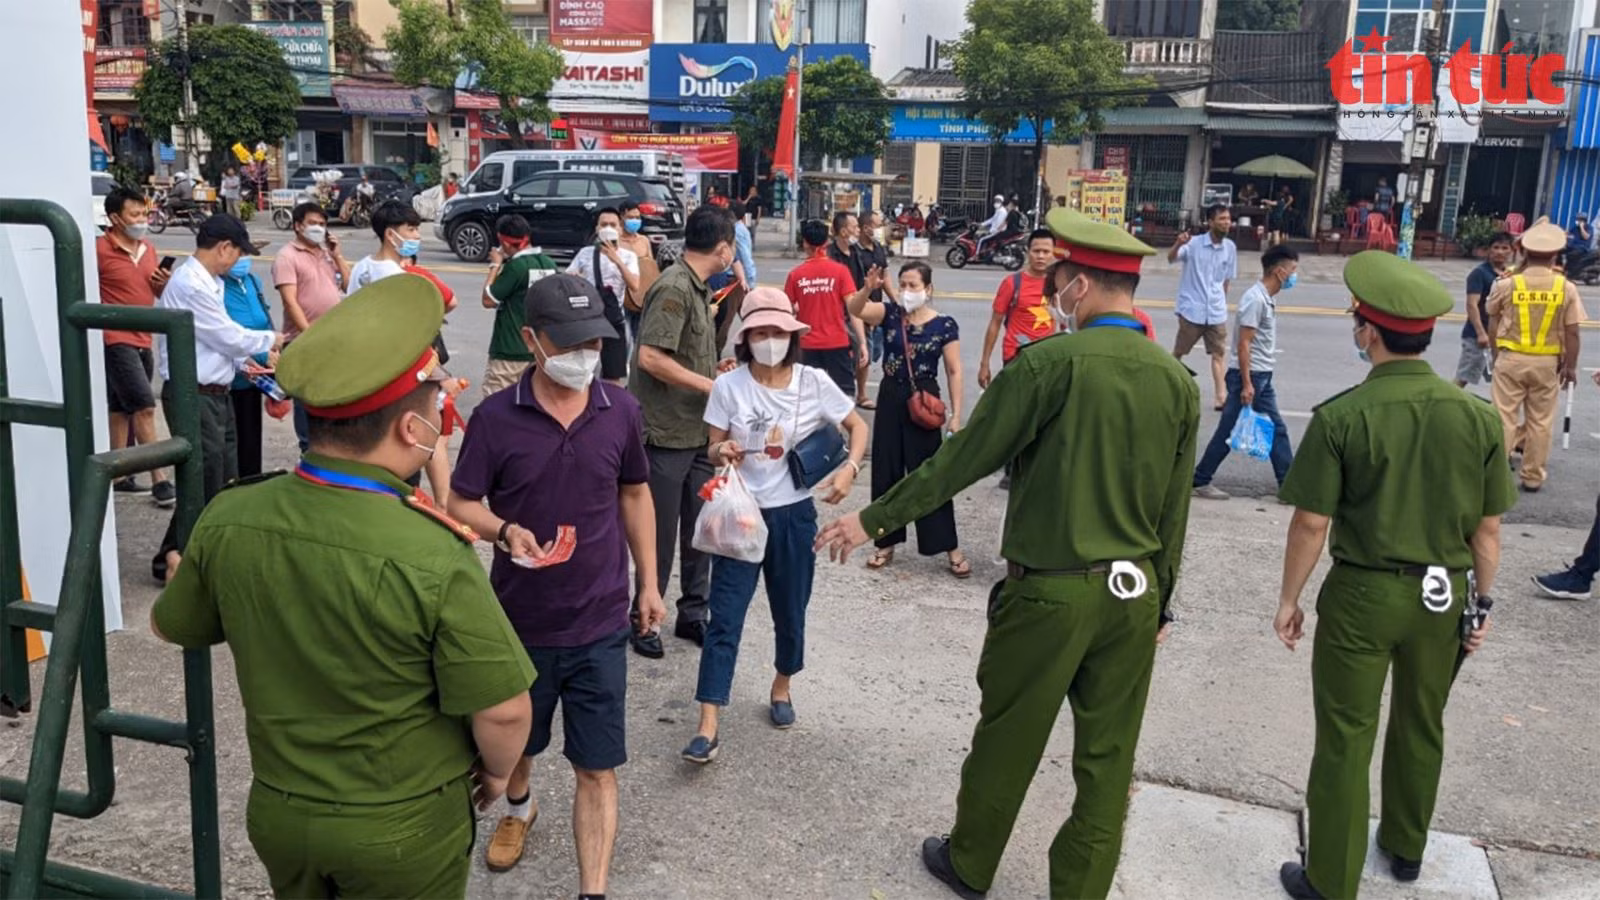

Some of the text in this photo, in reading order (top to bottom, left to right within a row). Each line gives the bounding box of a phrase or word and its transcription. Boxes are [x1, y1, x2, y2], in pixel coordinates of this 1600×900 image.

[585, 1, 604, 10] CAO
[560, 17, 604, 27] MASSAGE
[679, 75, 745, 97] Dulux
[1477, 137, 1524, 147] SERVICE
